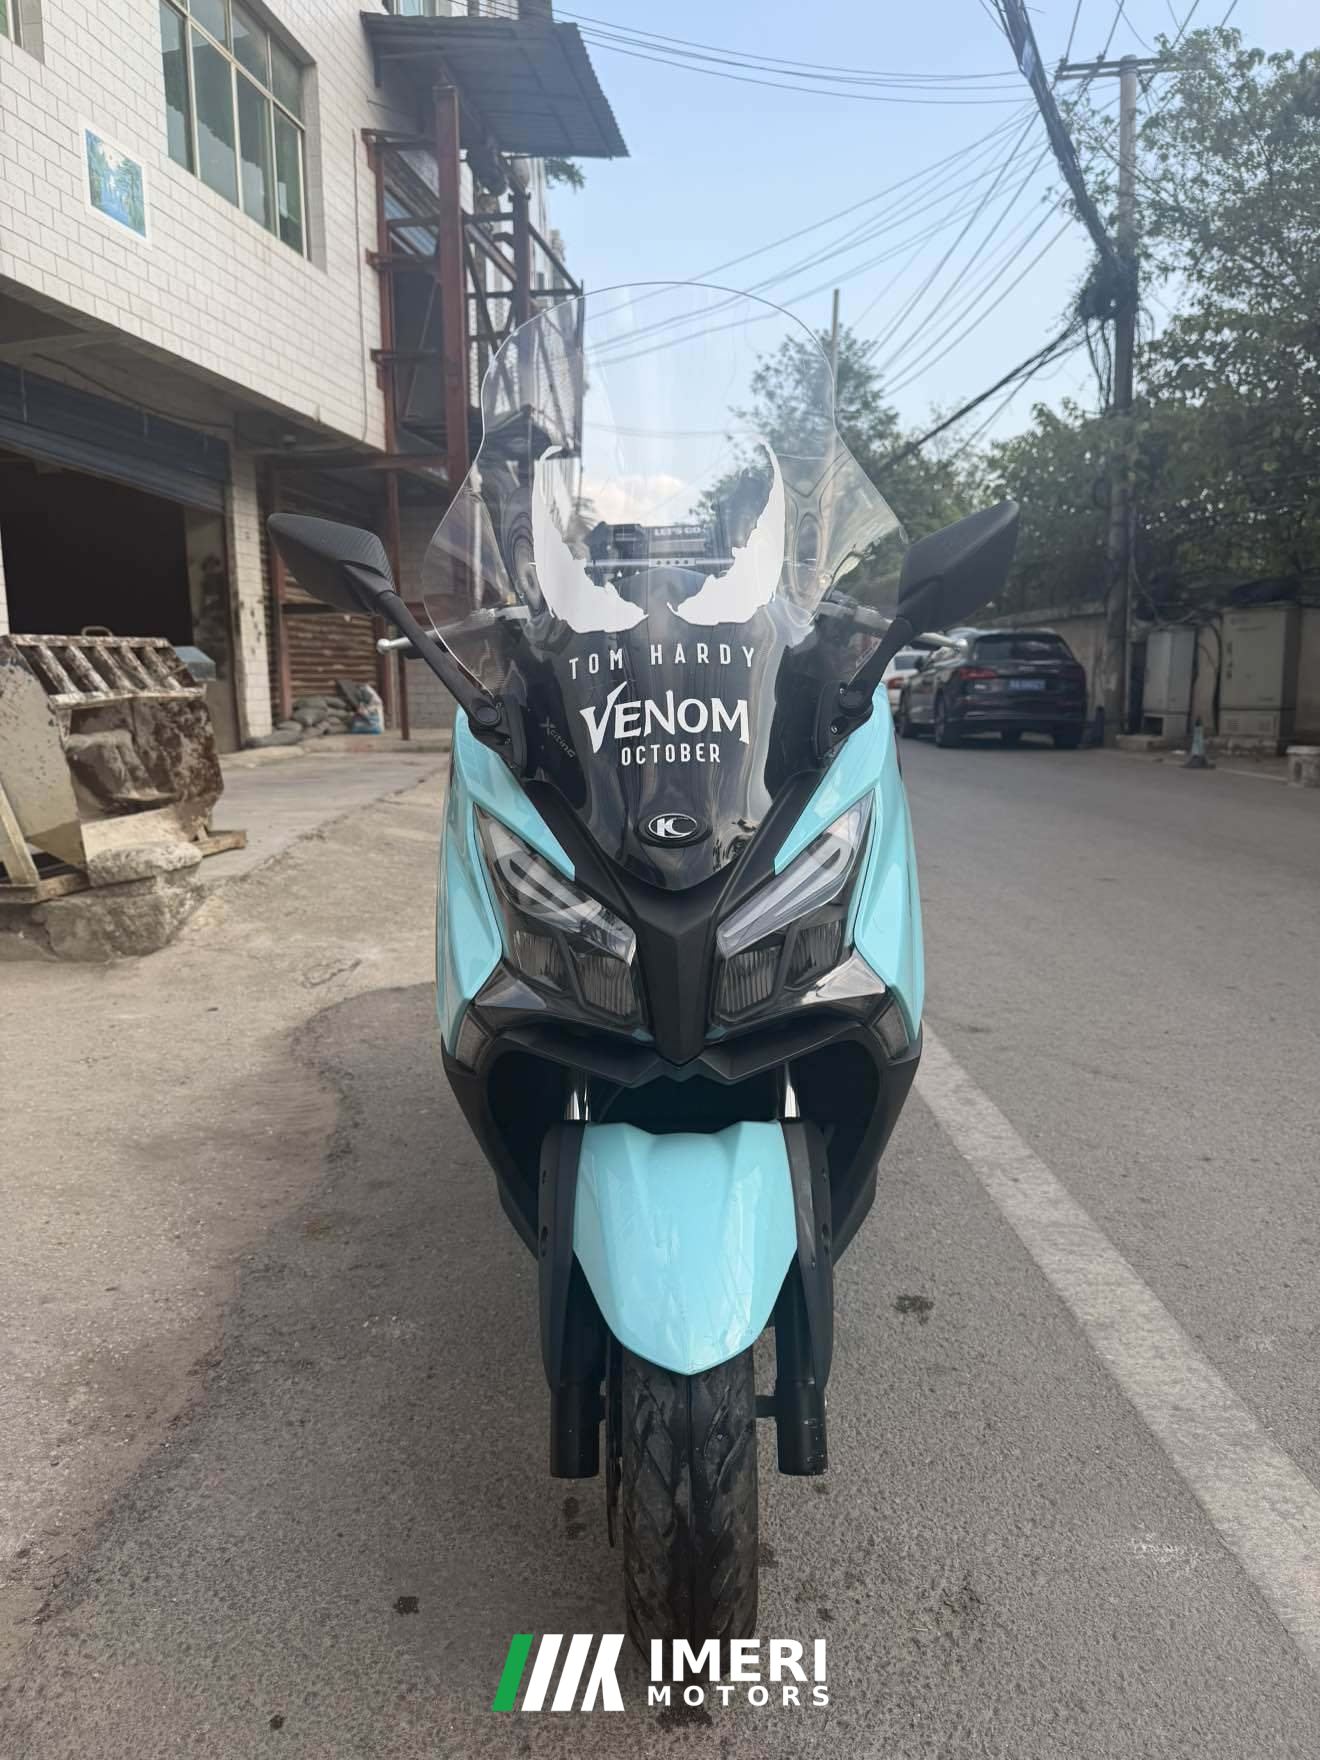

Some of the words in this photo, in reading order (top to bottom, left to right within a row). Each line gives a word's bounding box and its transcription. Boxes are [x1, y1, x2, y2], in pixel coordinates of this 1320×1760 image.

[568, 648, 624, 680] TOM
[650, 643, 755, 668] HARDY
[579, 680, 750, 753] VENOM
[621, 743, 721, 766] OCTOBER
